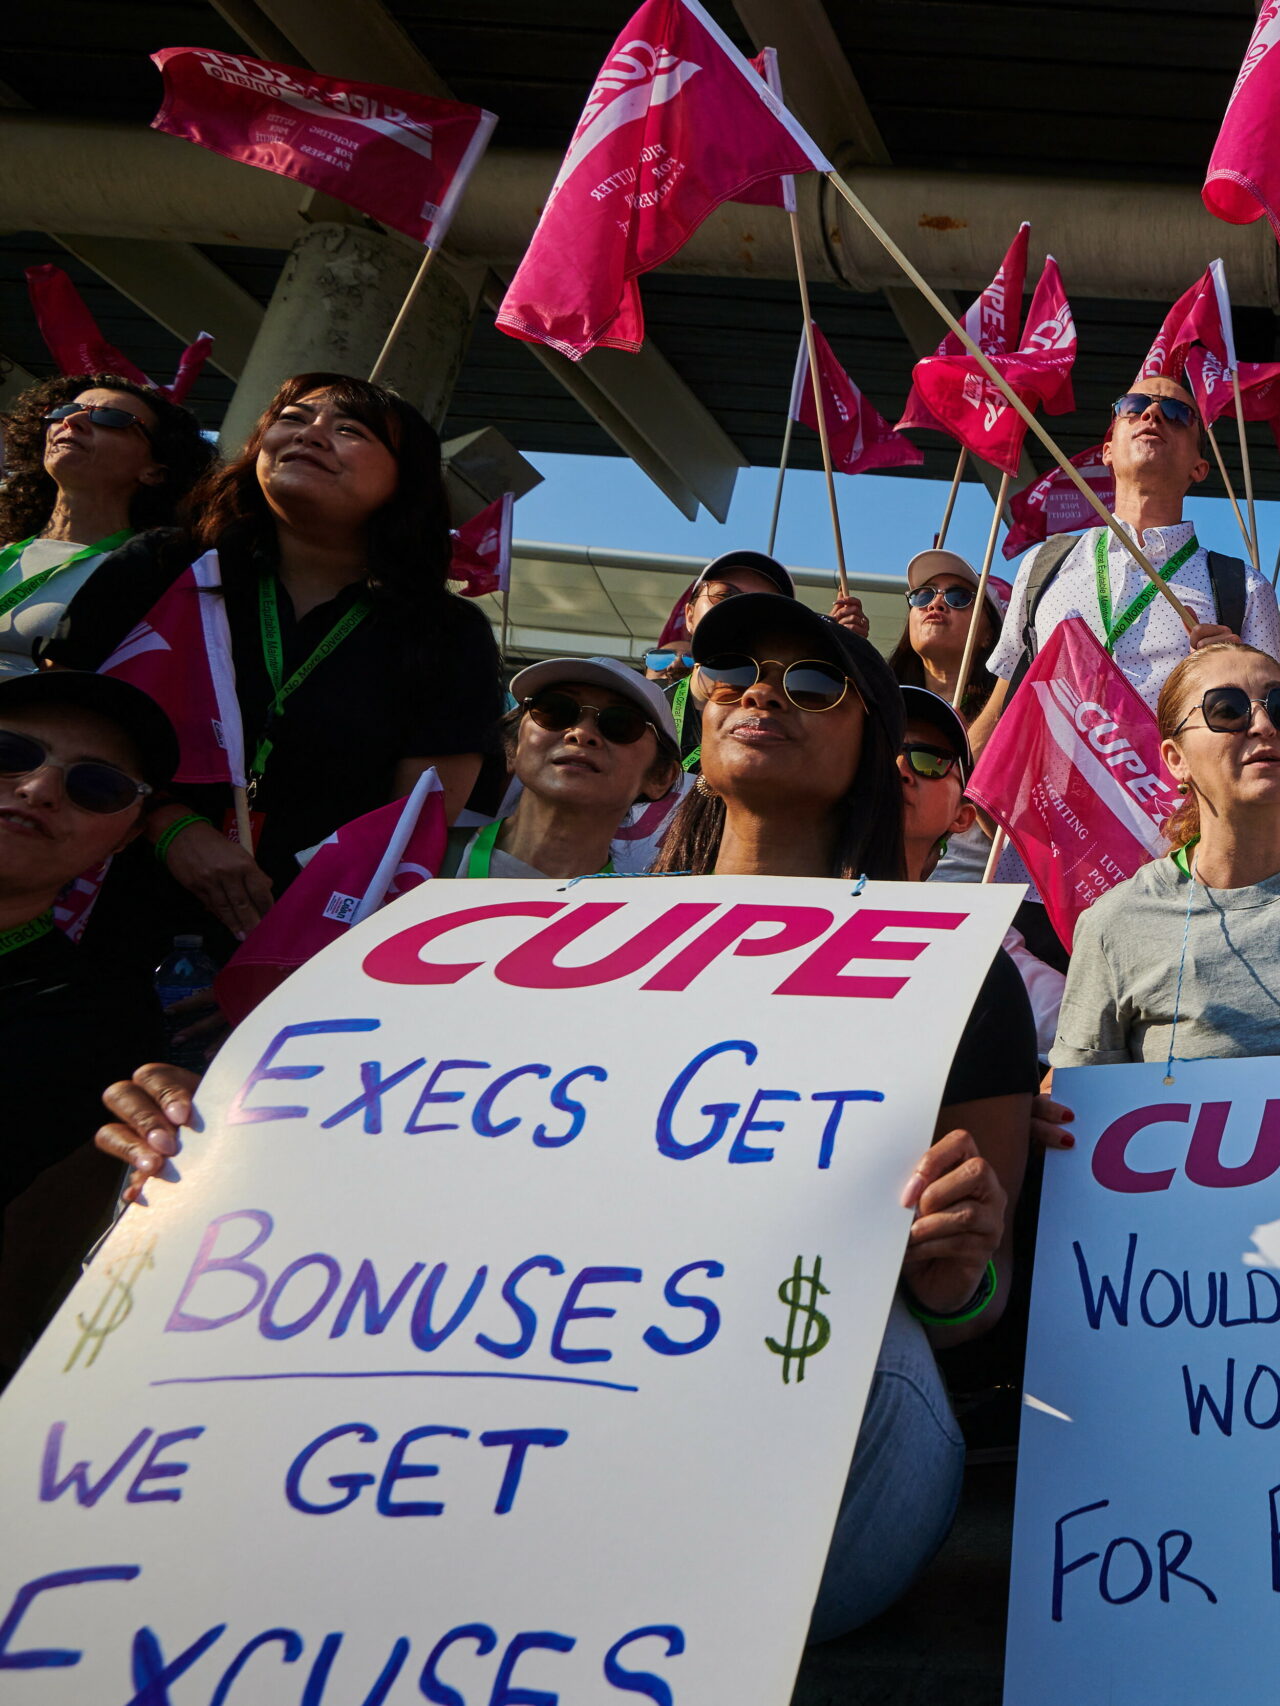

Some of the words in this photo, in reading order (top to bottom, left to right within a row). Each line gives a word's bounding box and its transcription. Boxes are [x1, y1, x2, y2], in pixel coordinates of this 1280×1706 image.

[1113, 623, 1126, 637] No
[1124, 602, 1145, 622] More
[1036, 783, 1049, 808] FOR
[1074, 701, 1171, 803] CUPE
[1042, 775, 1089, 841] FIGHTING
[1088, 868, 1112, 893] POU
[1099, 853, 1128, 881] LUT
[362, 901, 970, 999] CUPE
[226, 1018, 607, 1150] EXECS
[655, 1039, 884, 1170] GET
[162, 1209, 725, 1364] BONUSES
[39, 1419, 205, 1509] WE
[284, 1422, 569, 1519] GET
[1051, 1499, 1218, 1622] FOR
